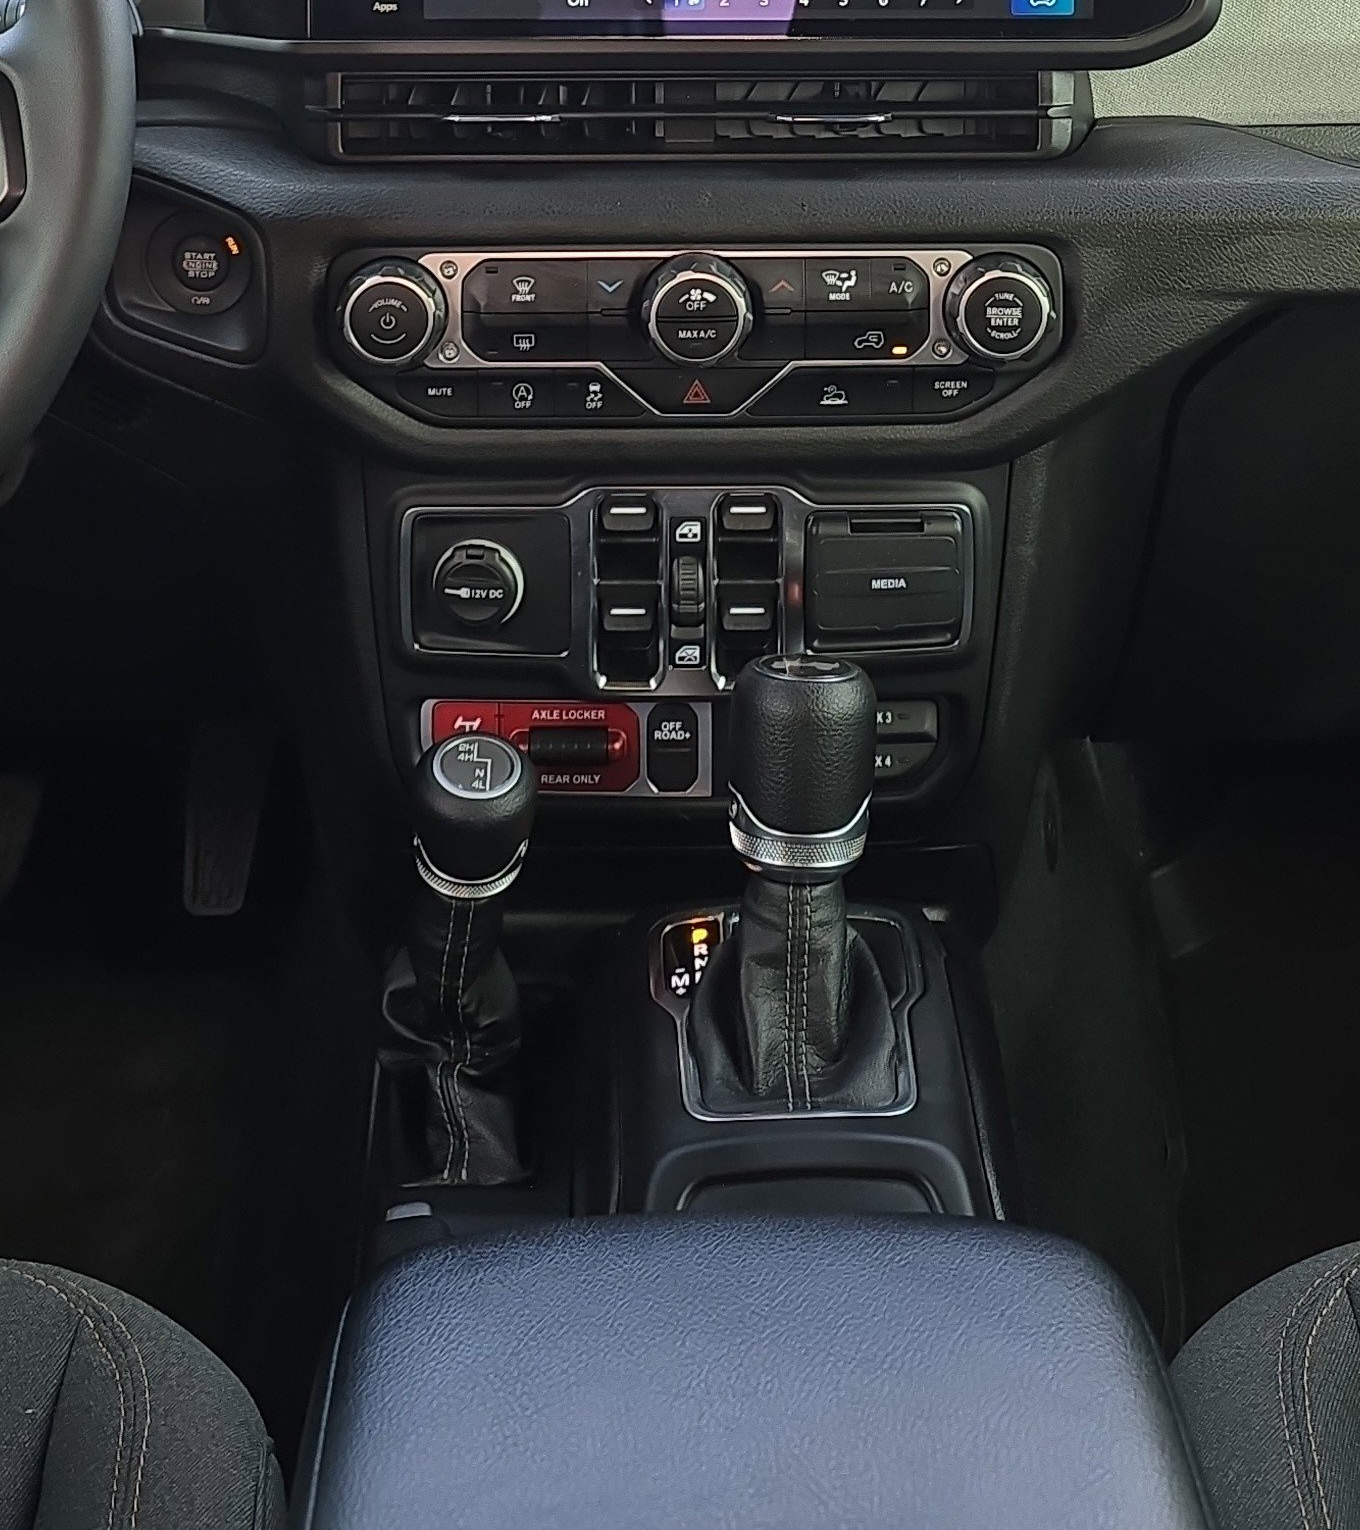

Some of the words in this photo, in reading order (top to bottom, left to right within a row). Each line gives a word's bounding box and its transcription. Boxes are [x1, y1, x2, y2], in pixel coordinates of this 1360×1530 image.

[373, 2, 399, 13] Apps
[184, 252, 216, 260] START
[187, 271, 216, 279] STOP
[889, 281, 914, 295] A/C
[511, 293, 537, 303] FRONT
[828, 293, 851, 302] MODE
[994, 292, 1015, 302] TUNE
[373, 298, 403, 309] VOLUME
[686, 301, 708, 312] OFF
[986, 307, 1023, 316] BROWSE
[991, 318, 1020, 327] ENTER
[678, 329, 699, 340] MAX
[699, 329, 717, 340] A/C
[990, 331, 1019, 341] SCROLL
[934, 381, 968, 390] SCREEN
[428, 387, 454, 397] MUTE
[942, 389, 959, 398] OFF
[514, 401, 532, 409] OFF
[585, 400, 603, 410] OFF
[871, 578, 907, 590] MEDIA
[471, 589, 488, 599] 12V
[489, 589, 504, 599] DC
[531, 710, 561, 720] AXLE
[563, 710, 606, 720] LOCKER
[661, 722, 683, 732] OFF
[457, 753, 475, 762] 4H
[475, 768, 485, 778] N
[541, 775, 571, 784] REAR
[572, 774, 602, 785] ONLY
[472, 780, 486, 790] 4L
[694, 943, 709, 957] R
[695, 956, 709, 971] N
[671, 973, 690, 989] M
